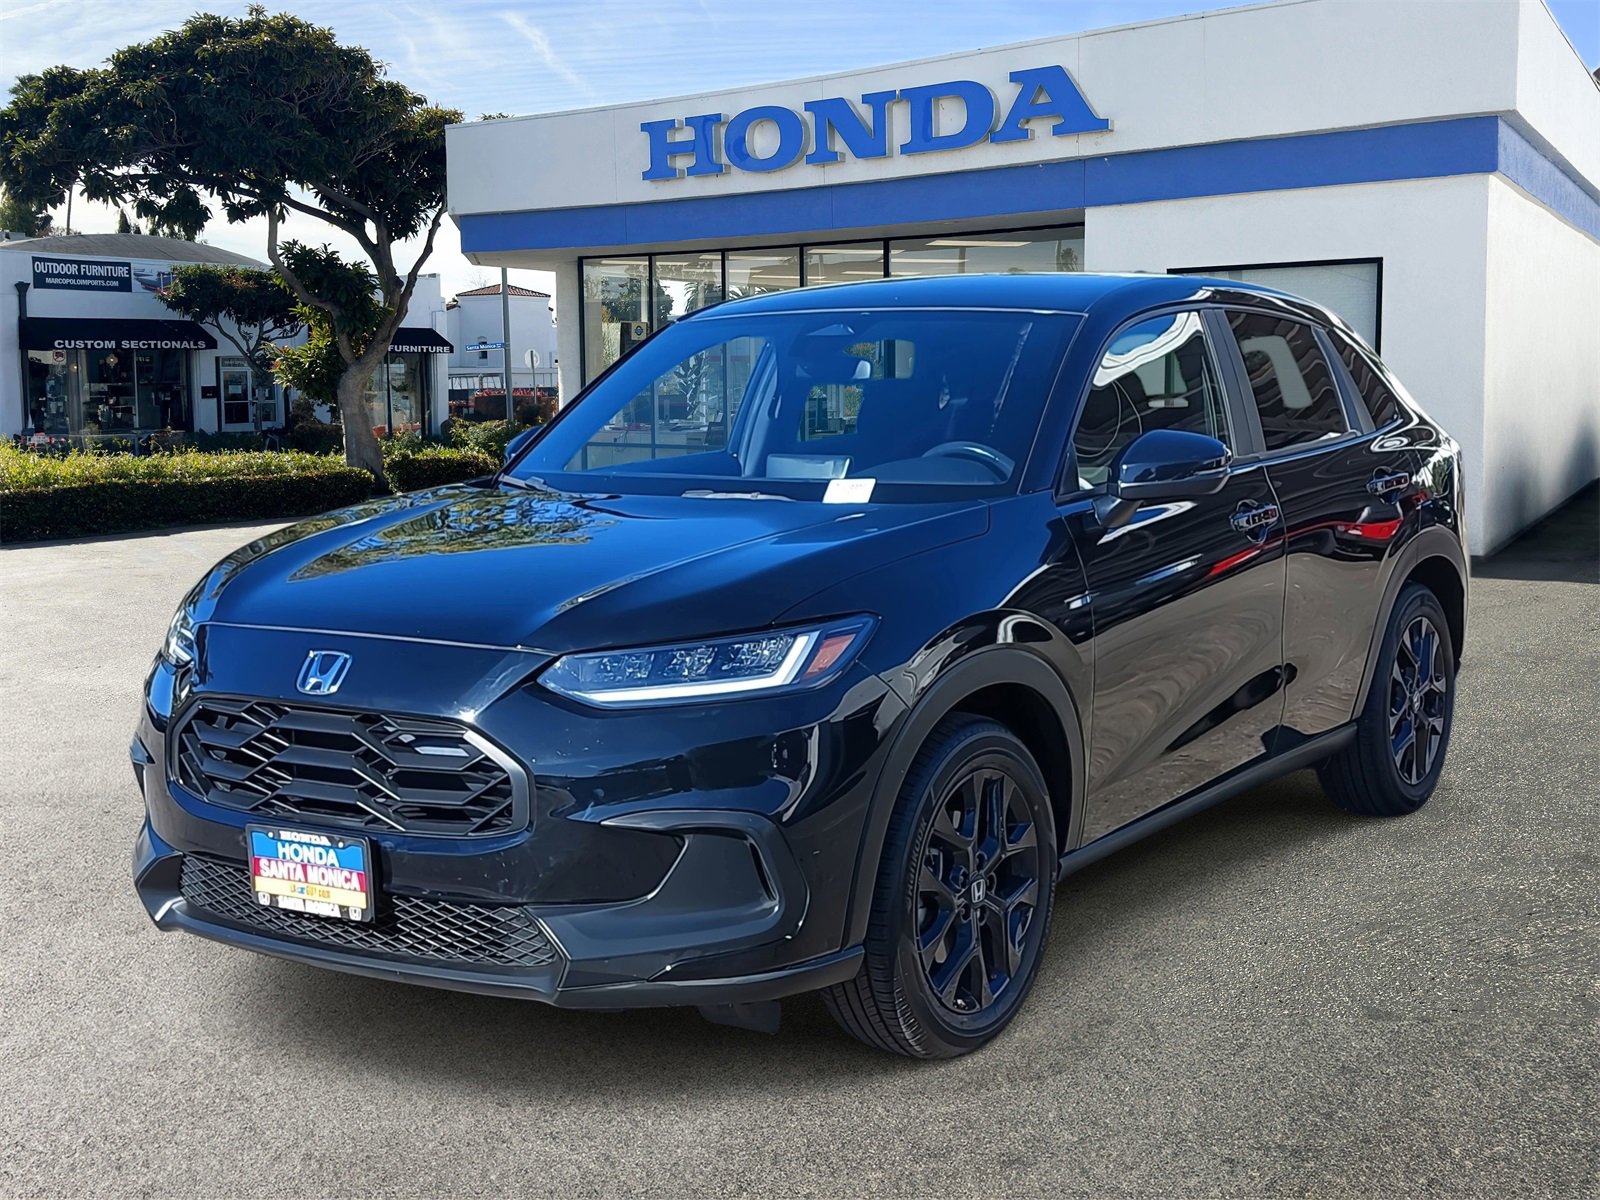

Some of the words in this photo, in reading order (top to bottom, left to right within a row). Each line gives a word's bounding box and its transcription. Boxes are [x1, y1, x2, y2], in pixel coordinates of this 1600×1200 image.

[641, 65, 1114, 181] HONDA
[34, 261, 79, 275] OUTDOOR
[80, 264, 130, 278] FURNITURE
[45, 277, 119, 287] MARCOPOLOIMPORTS.COM
[54, 339, 116, 349] CUSTOM
[121, 340, 206, 349] SECTIONALS
[388, 344, 450, 353] FURNITURE
[277, 841, 340, 868] HONDA
[260, 858, 305, 883] SANTA
[306, 865, 361, 892] MONICA
